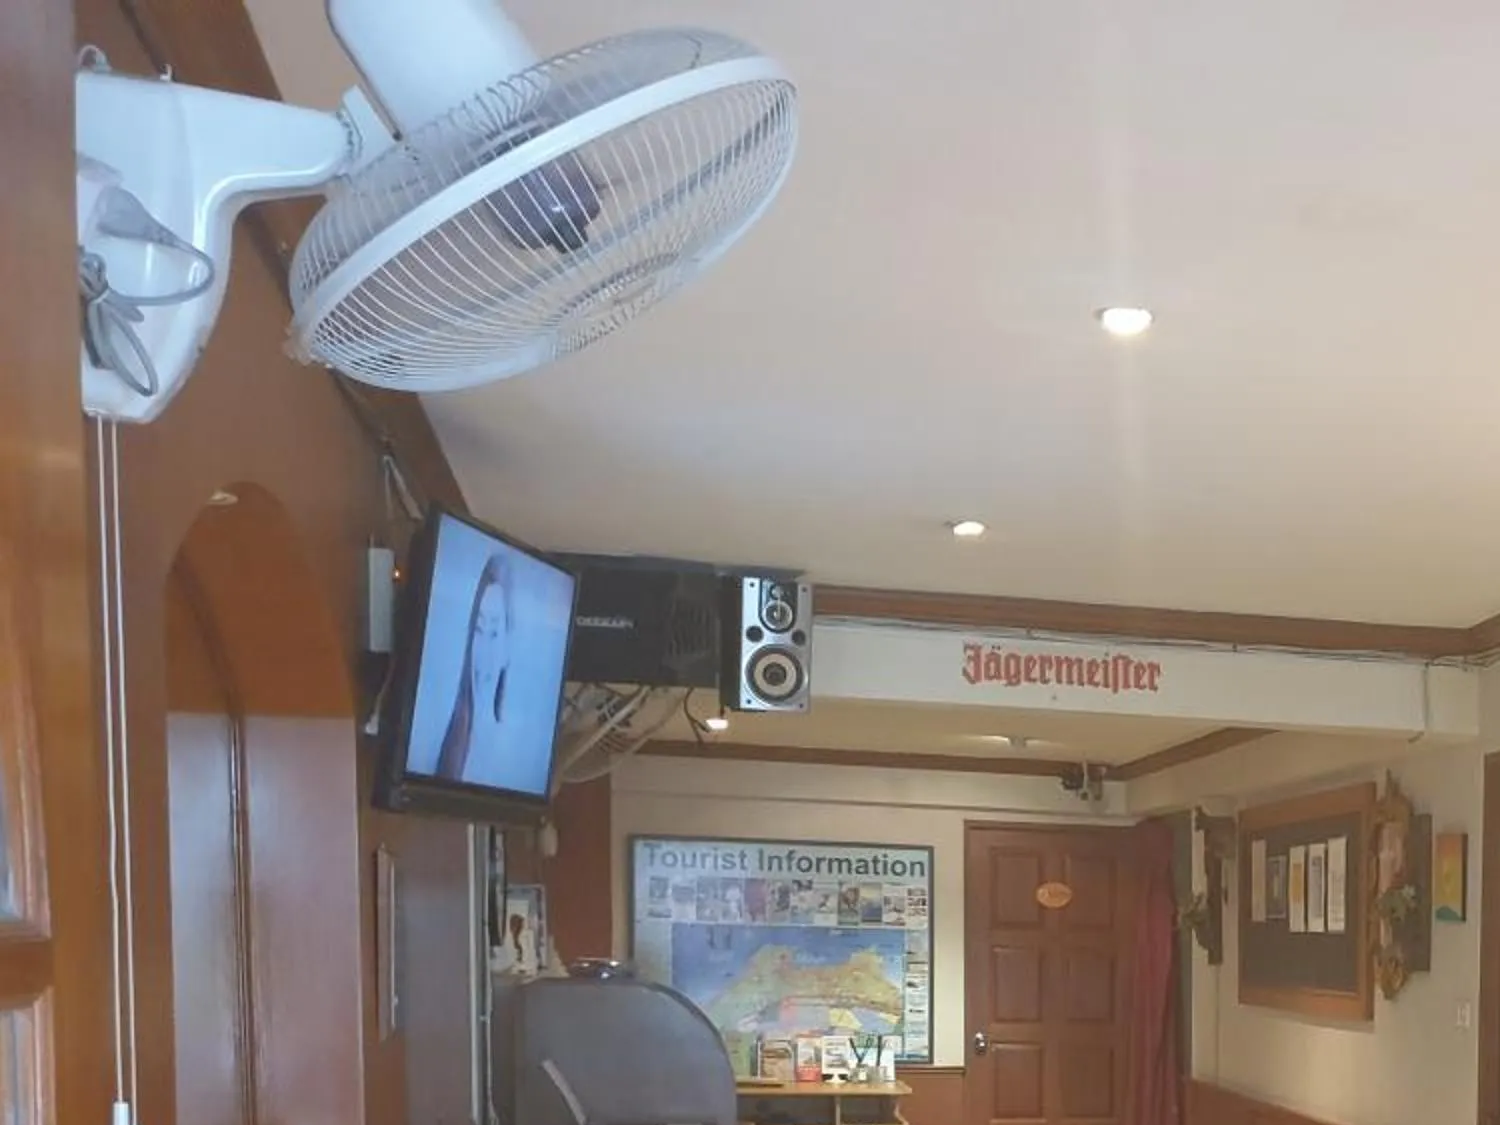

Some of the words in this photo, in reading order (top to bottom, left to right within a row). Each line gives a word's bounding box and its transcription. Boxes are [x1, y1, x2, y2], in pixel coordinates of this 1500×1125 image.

[962, 643, 1161, 693] Jägermeister
[644, 843, 748, 871] Tourist
[758, 848, 926, 878] Information
